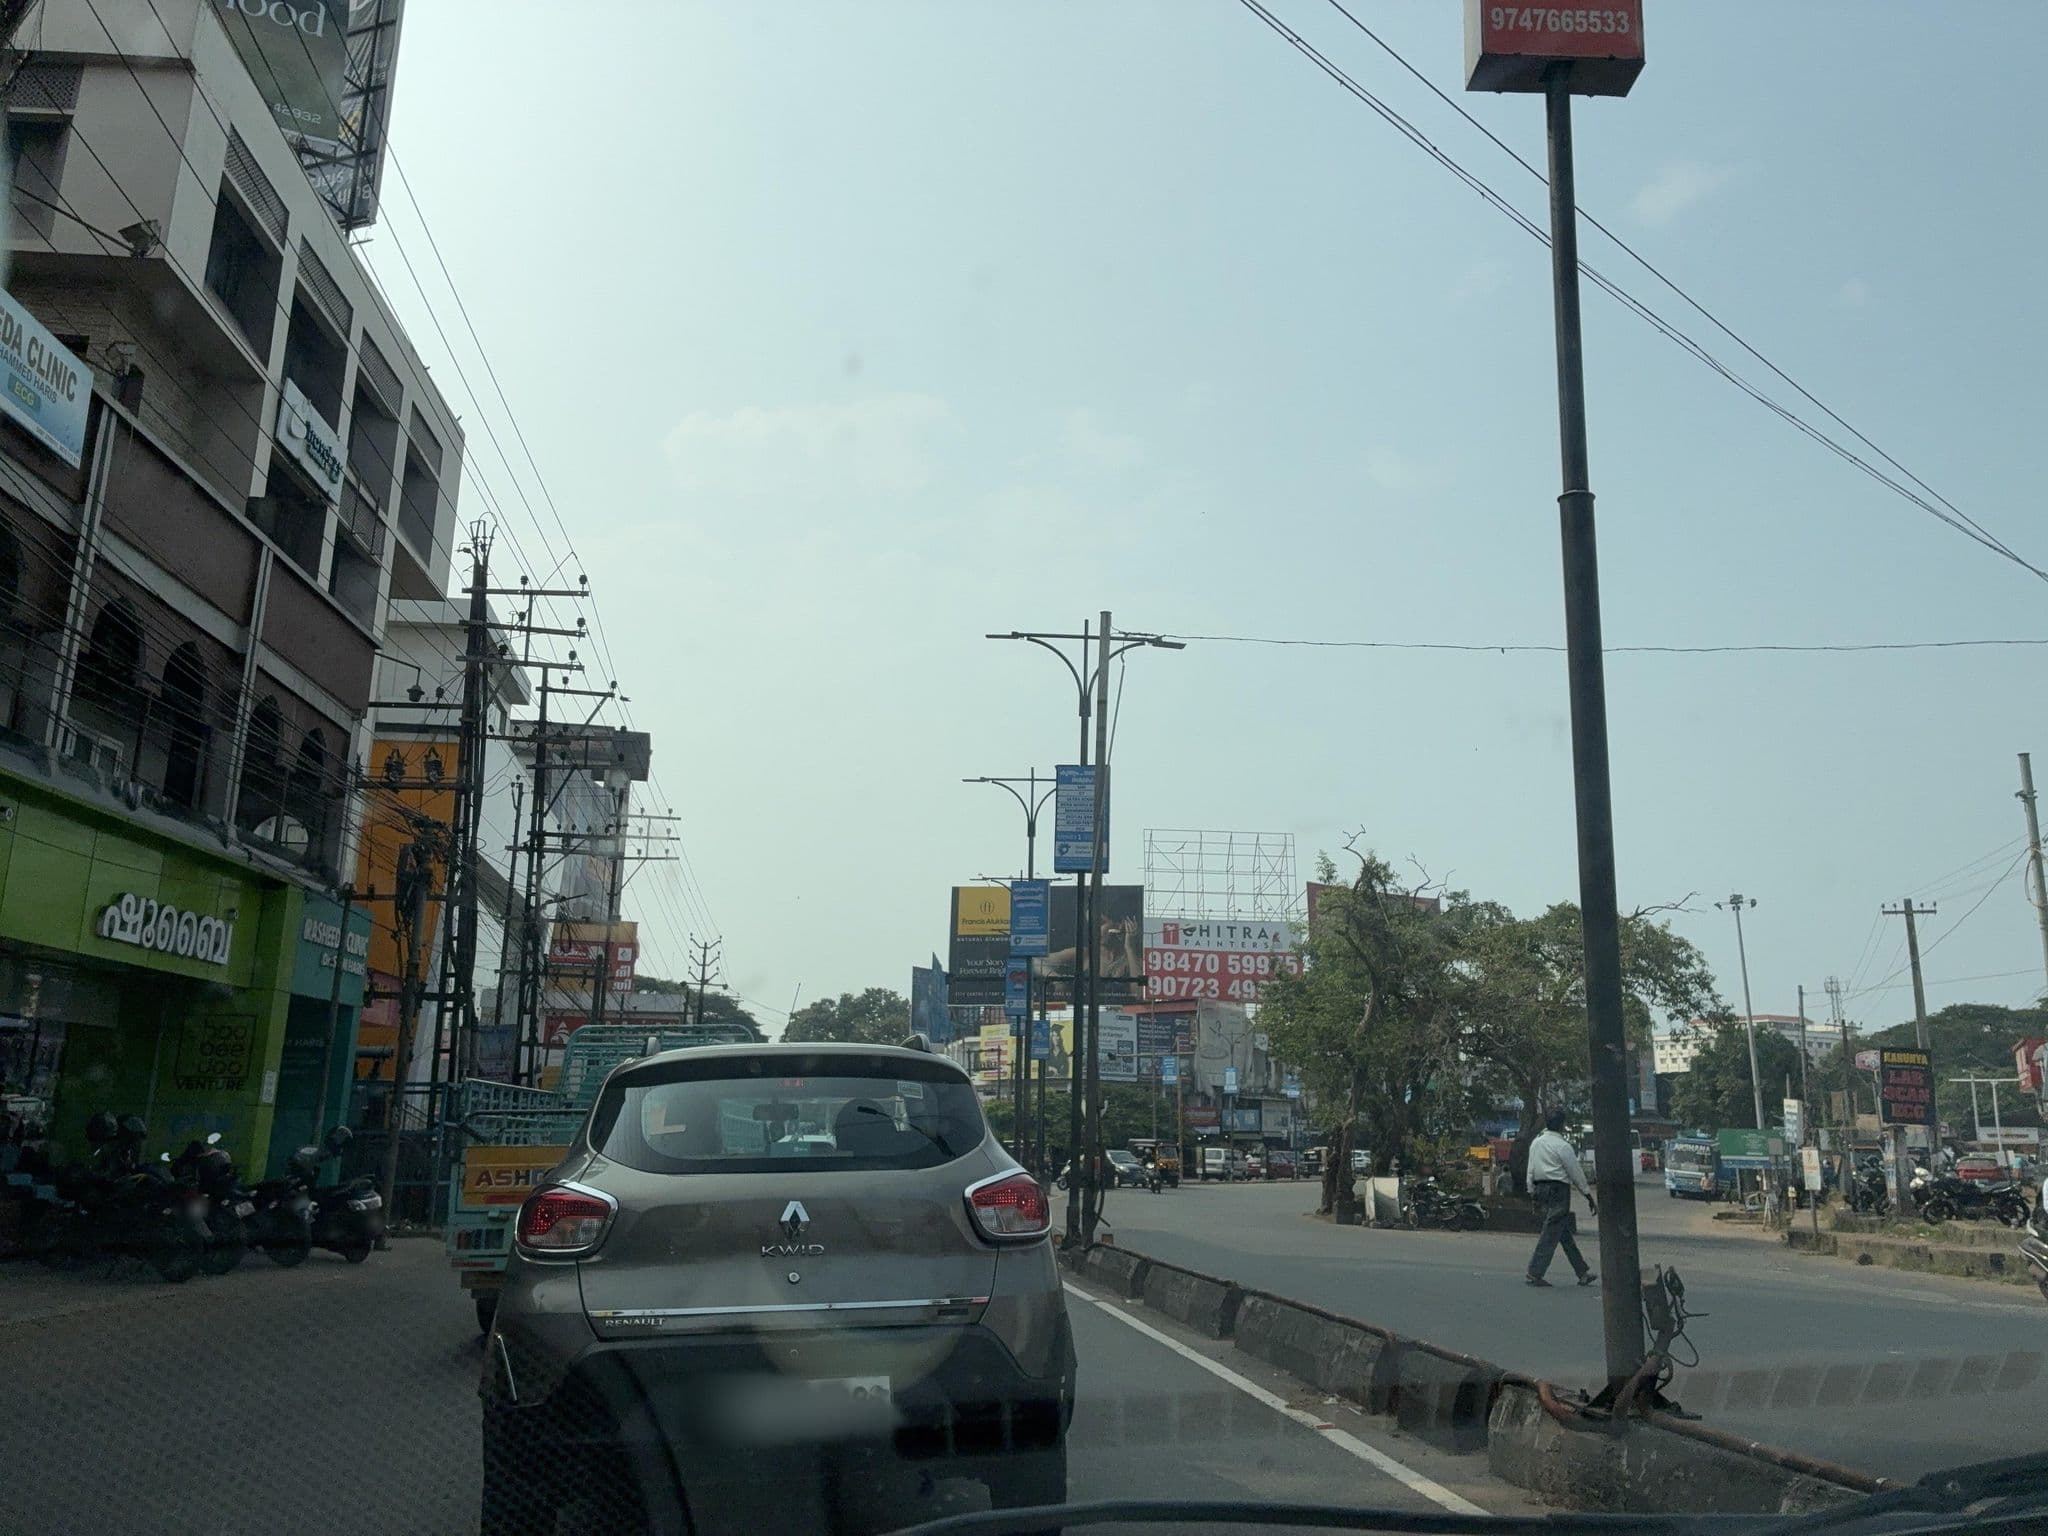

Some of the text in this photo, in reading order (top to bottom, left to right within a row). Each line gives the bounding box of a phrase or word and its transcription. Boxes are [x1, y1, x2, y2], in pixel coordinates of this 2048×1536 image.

[225, 0, 326, 37] ood
[1491, 8, 1629, 34] 9747665533
[27, 335, 78, 402] CLINIC
[34, 376, 58, 404] HARIS
[303, 918, 341, 949] RASHEED
[1183, 924, 1269, 941] CHITRA
[1184, 939, 1270, 949] PAINTERS
[966, 959, 1005, 969] Your Story
[1149, 951, 1220, 974] 98470
[960, 967, 989, 976] Forever
[1149, 975, 1220, 998] 90723
[175, 1077, 246, 1091] VENTURE
[1884, 1087, 1930, 1103] SCAN
[761, 1244, 825, 1257] KWID
[605, 1317, 665, 1328] RENAULT
